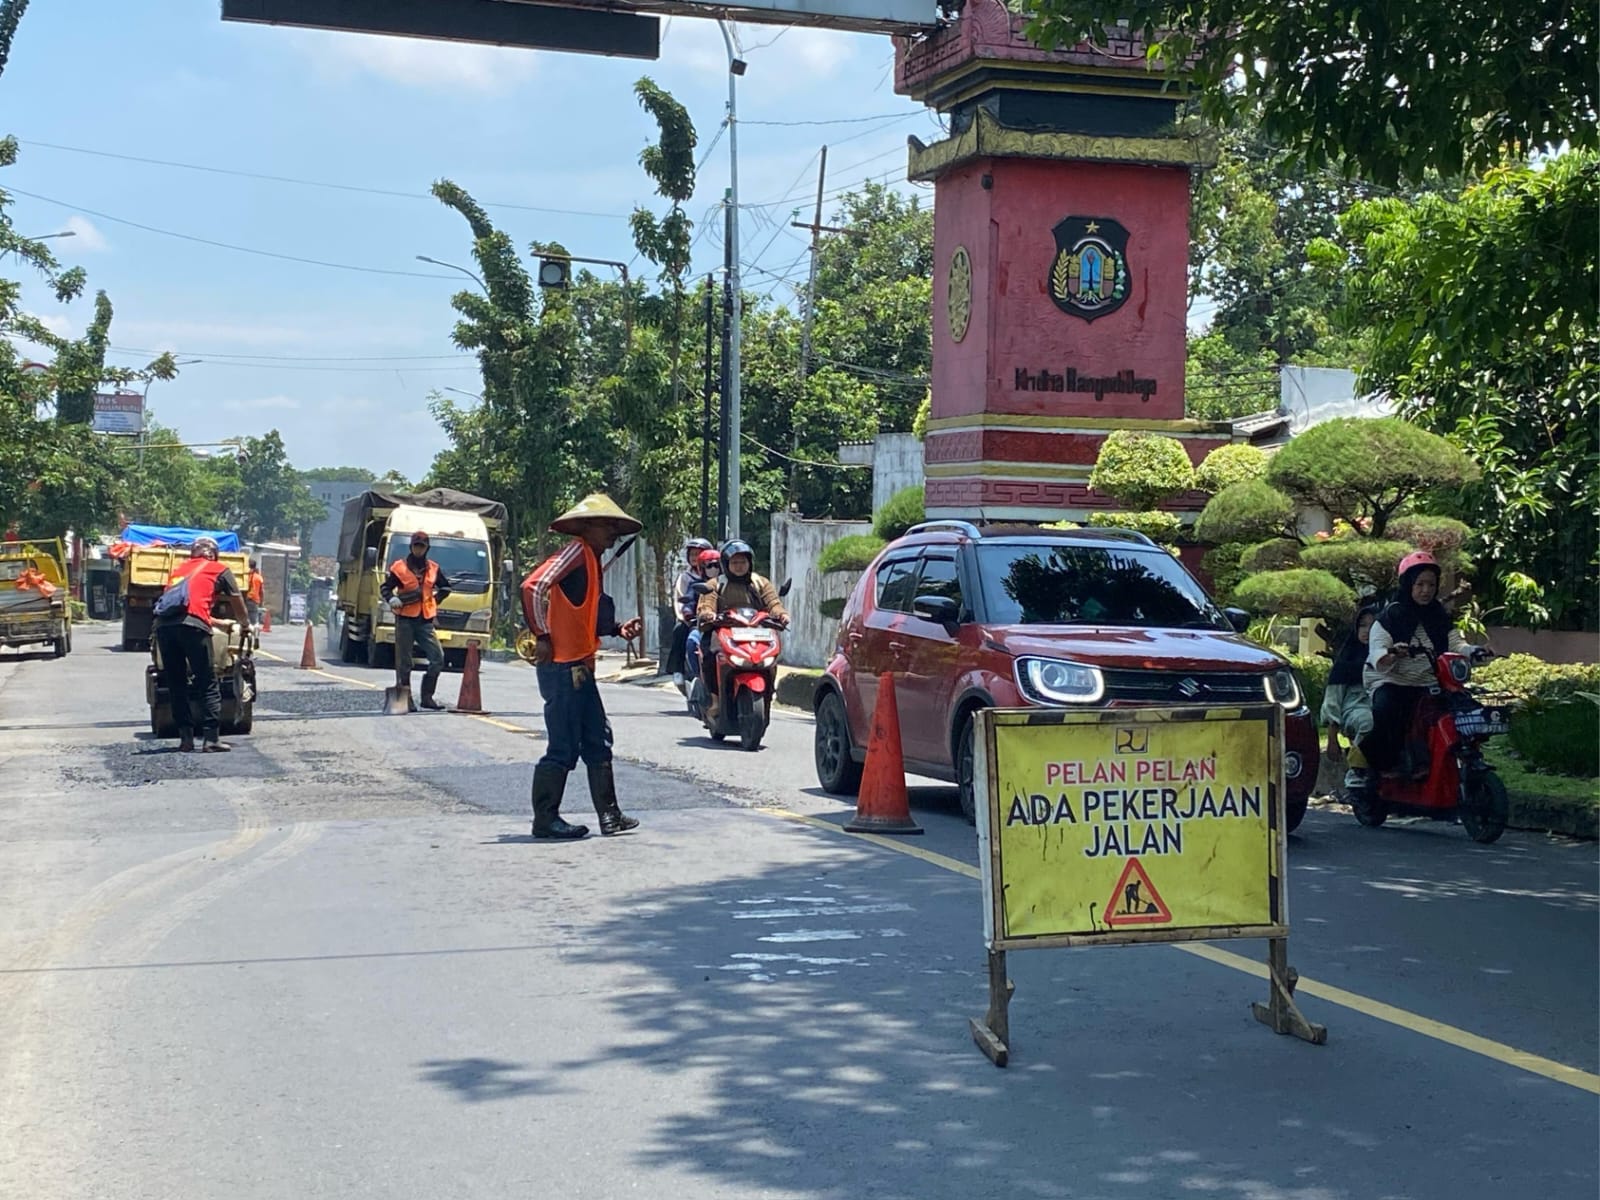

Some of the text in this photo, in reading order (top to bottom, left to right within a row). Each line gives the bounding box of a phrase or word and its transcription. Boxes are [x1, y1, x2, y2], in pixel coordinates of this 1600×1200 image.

[1046, 758, 1216, 785] PELAN PELAN
[1006, 786, 1261, 826] ADA PEKERJAAN
[1085, 823, 1182, 857] JALAN
